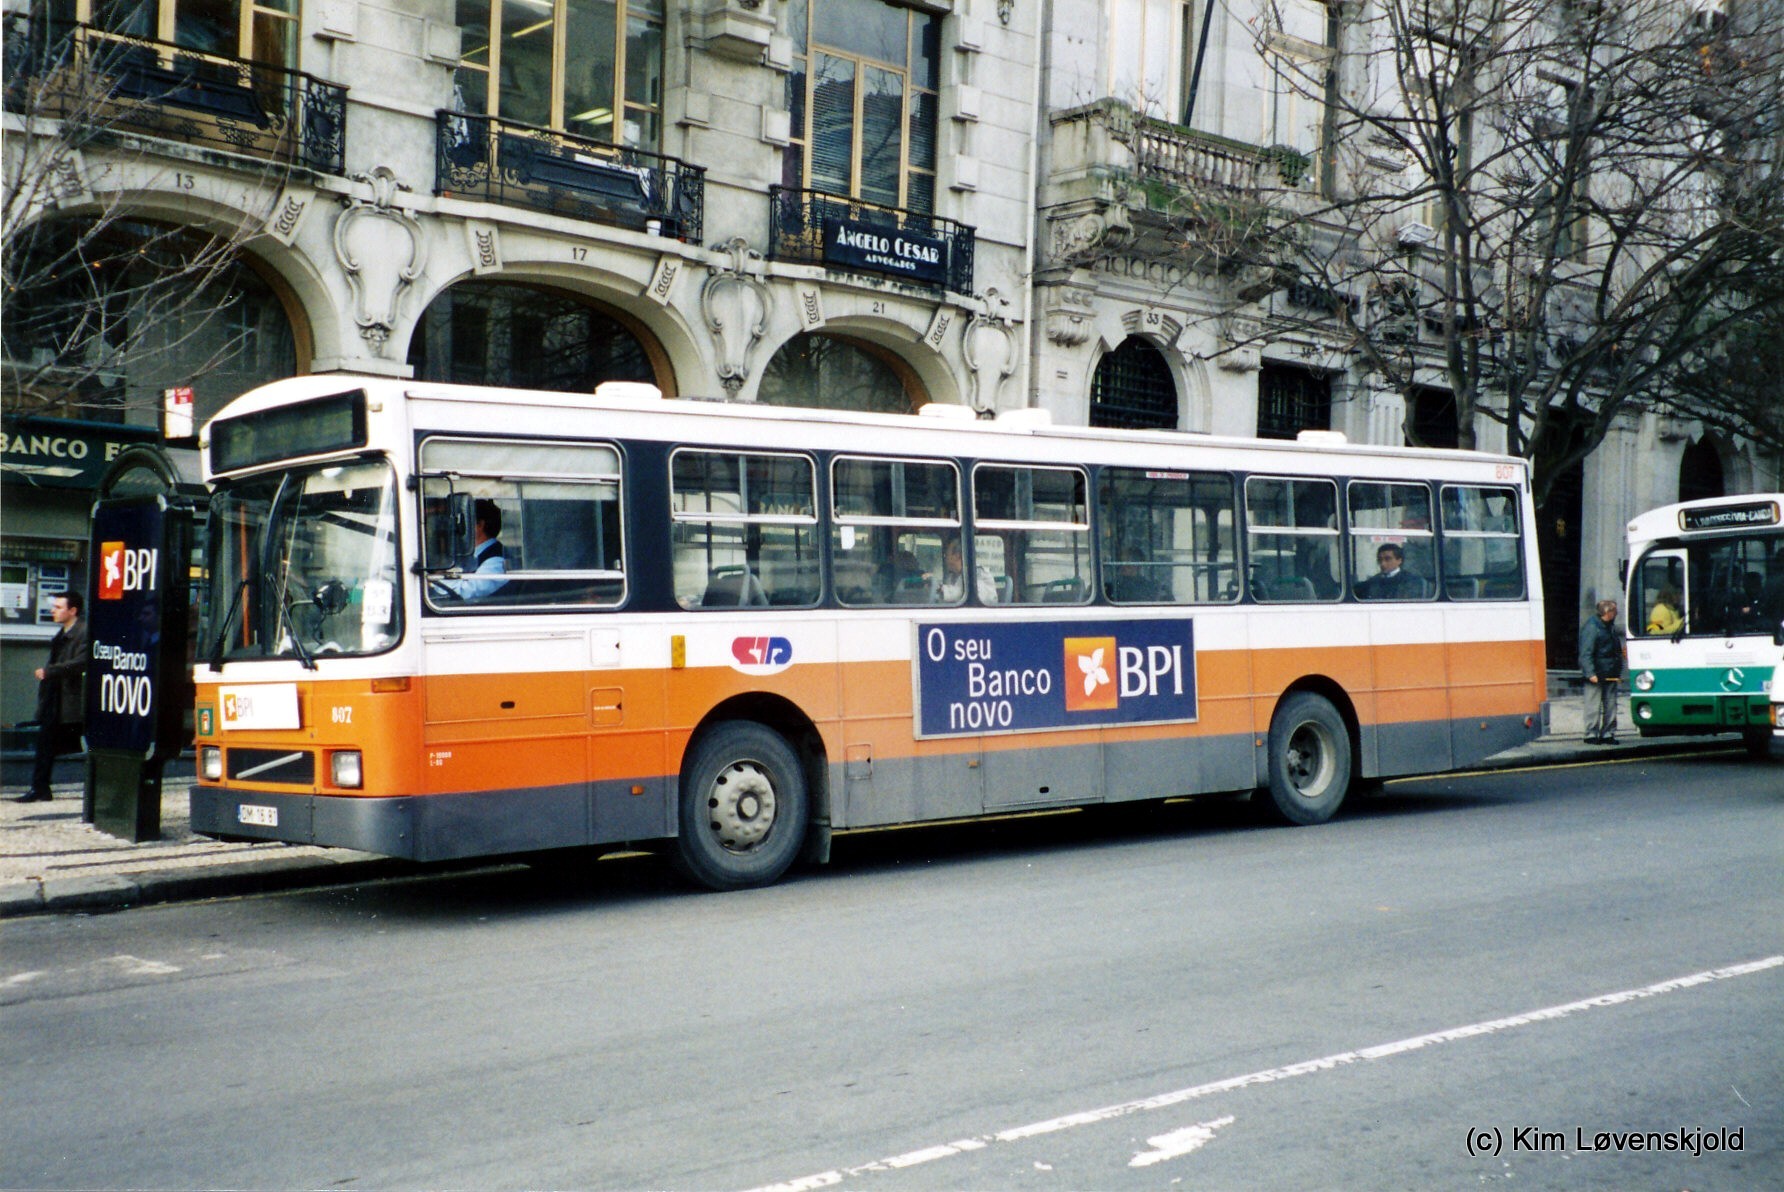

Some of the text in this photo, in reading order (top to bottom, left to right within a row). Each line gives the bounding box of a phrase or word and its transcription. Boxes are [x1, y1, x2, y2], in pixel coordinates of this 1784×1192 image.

[176, 172, 194, 190] 13
[837, 225, 890, 254] ANGELO
[573, 247, 588, 261] 17
[873, 301, 885, 314] 21
[1146, 312, 1159, 325] 33
[1, 432, 88, 460] BANCO
[1495, 466, 1514, 480] 807
[122, 548, 158, 591] BPI
[926, 628, 991, 662] O seu
[113, 646, 147, 672] Banco
[968, 645, 1184, 698] Banco BPI
[101, 673, 152, 718] novo
[237, 697, 254, 718] BPI
[332, 706, 352, 723] 807
[950, 700, 1013, 730] novo
